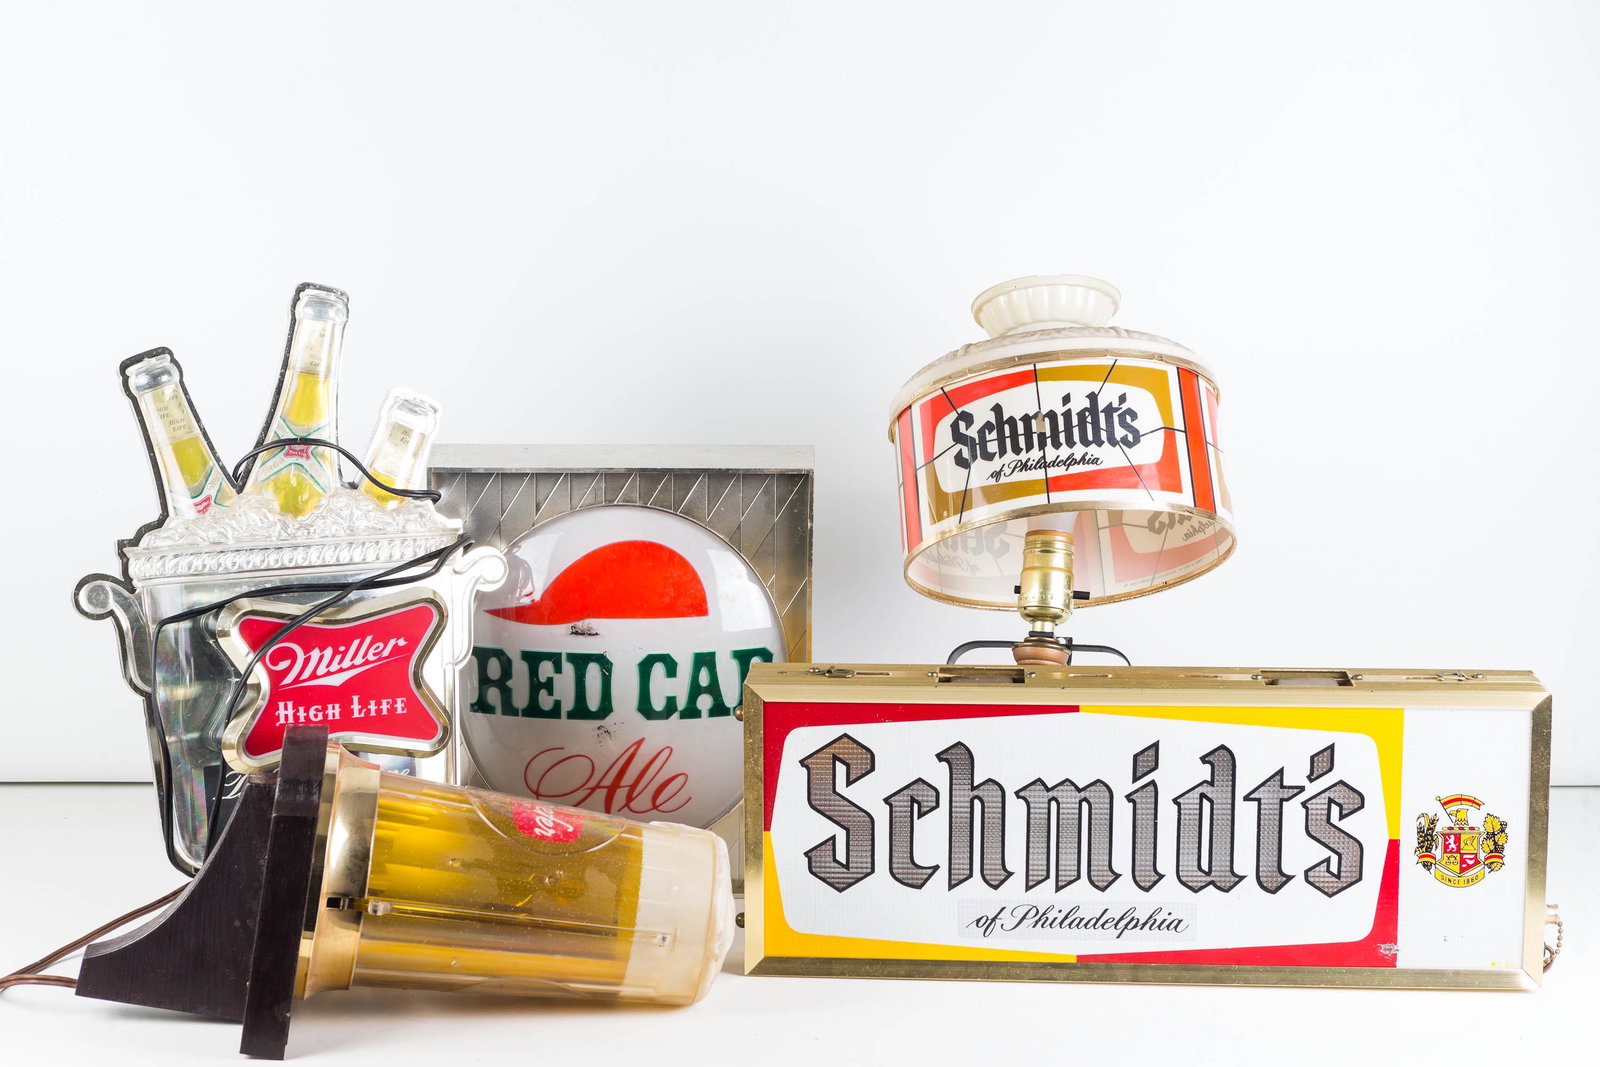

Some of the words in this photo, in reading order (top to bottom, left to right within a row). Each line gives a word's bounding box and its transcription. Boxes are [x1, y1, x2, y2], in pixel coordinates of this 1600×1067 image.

[950, 391, 1141, 470] Schmidt's
[986, 465, 1006, 483] of
[1003, 451, 1104, 478] Philadelphia
[265, 634, 410, 690] Miller
[469, 646, 614, 721] RED
[275, 700, 341, 727] HIGH
[351, 695, 408, 719] LIFE
[523, 737, 693, 815] Ale
[533, 806, 574, 837] efer
[799, 733, 1367, 898] Schmidt's
[1463, 874, 1480, 885] 1860
[965, 905, 1007, 938] of
[1000, 903, 1190, 940] Philadelphia
